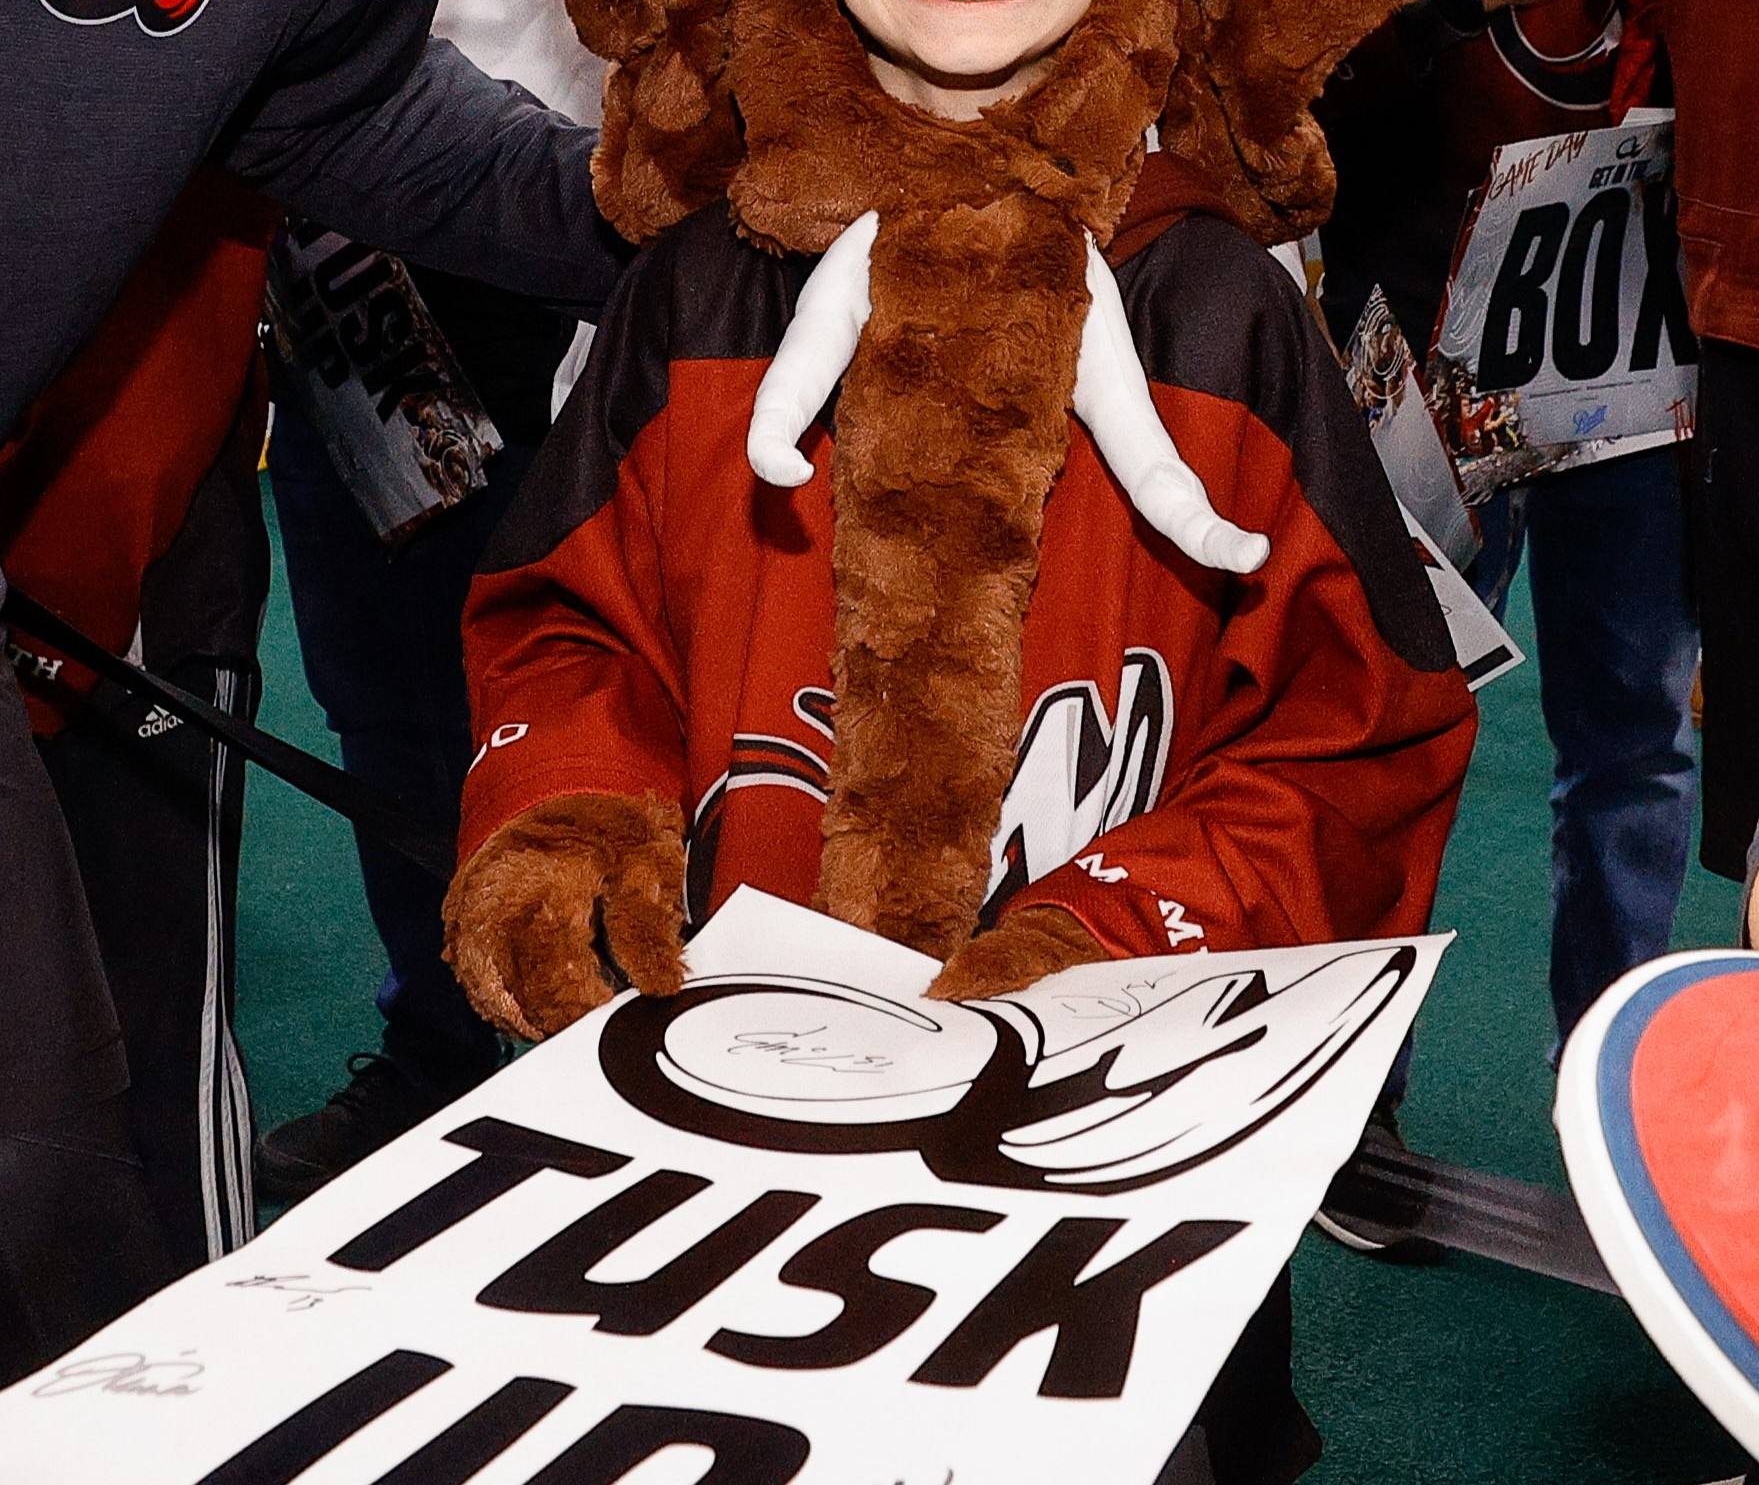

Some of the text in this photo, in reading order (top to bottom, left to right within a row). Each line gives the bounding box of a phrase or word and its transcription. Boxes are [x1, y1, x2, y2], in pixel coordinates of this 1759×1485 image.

[1489, 131, 1588, 201] GAME DAY
[1475, 182, 1700, 393] BOX
[325, 1115, 1253, 1400] TUSK
